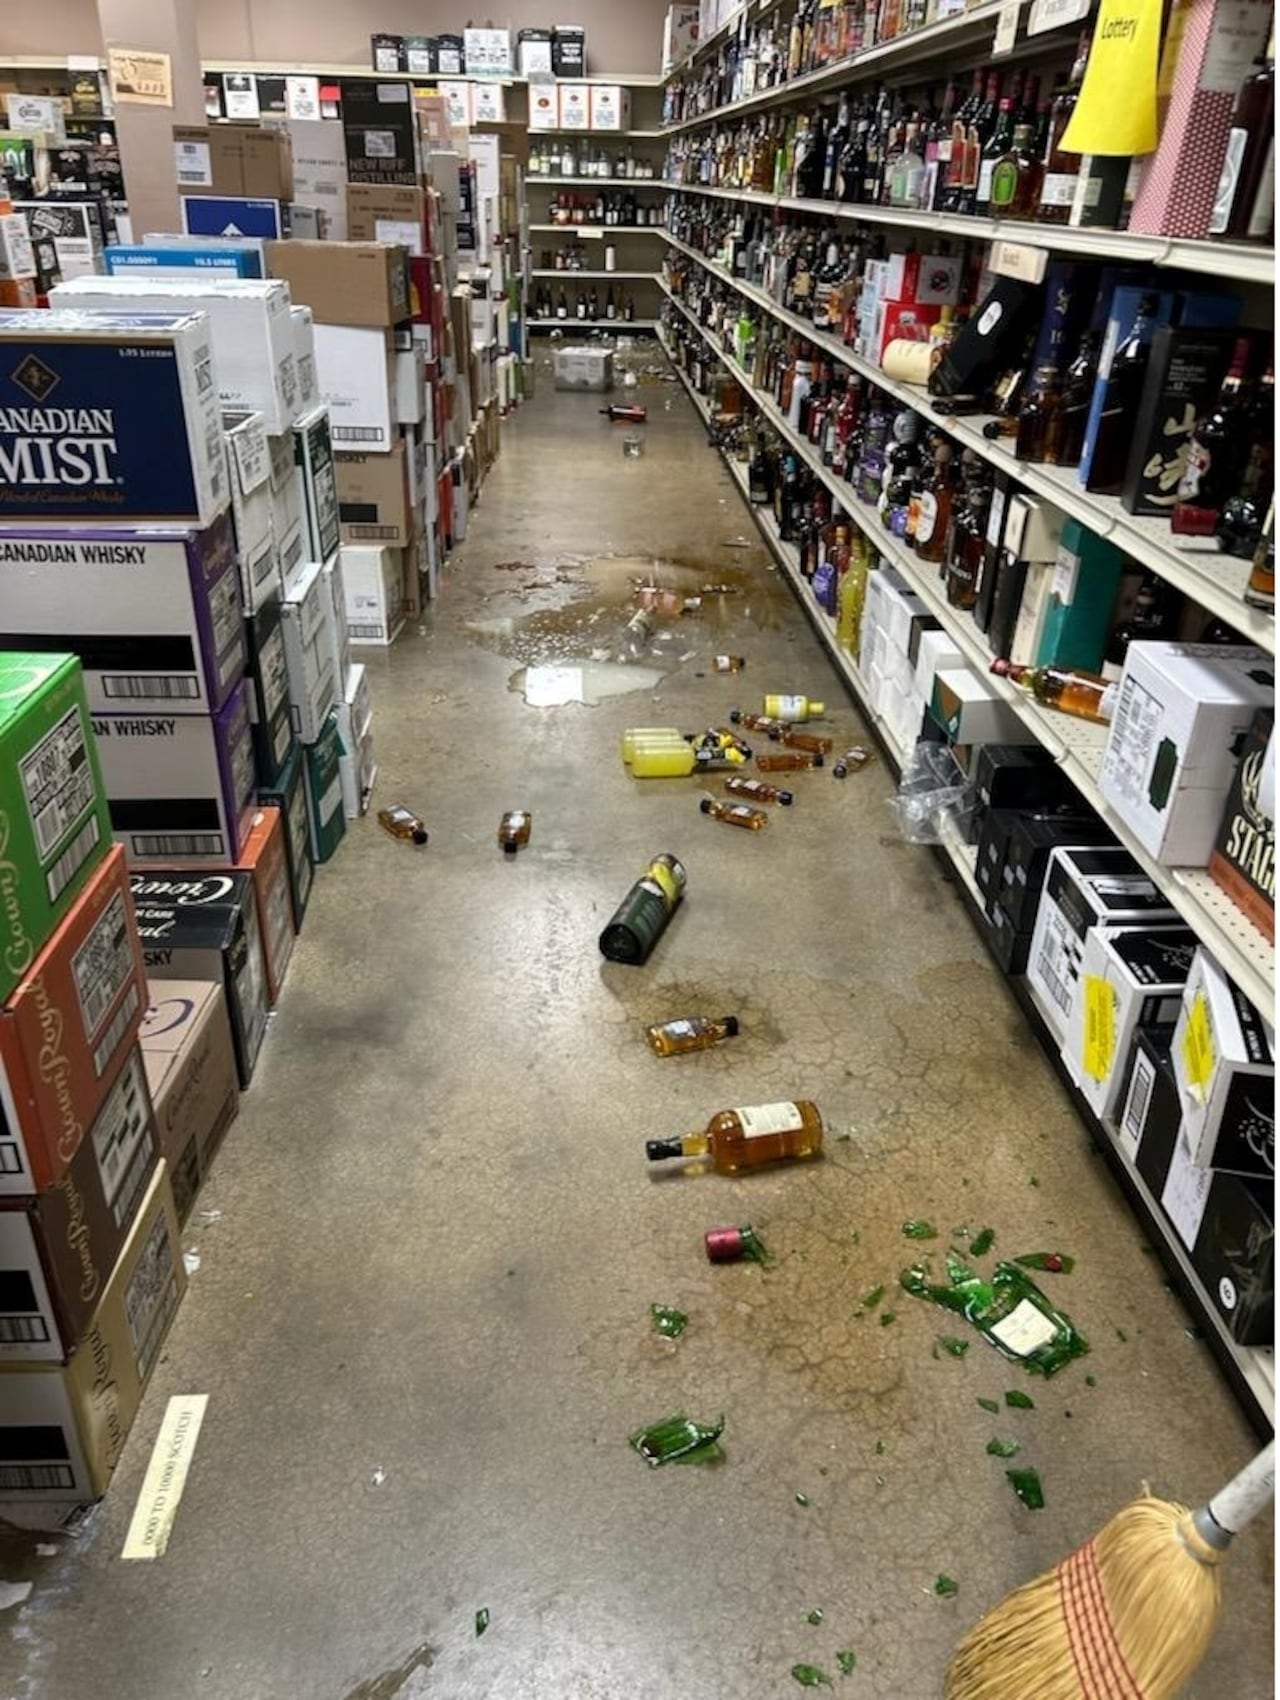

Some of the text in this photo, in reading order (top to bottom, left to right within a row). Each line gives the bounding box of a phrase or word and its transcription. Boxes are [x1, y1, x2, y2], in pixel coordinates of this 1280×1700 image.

[0, 406, 114, 434] ANADIAN
[0, 436, 118, 485] MIST
[79, 544, 146, 564] WHISKY
[113, 719, 176, 737] WHISKY
[1226, 814, 1275, 899] STAG
[143, 950, 172, 967] SKY
[168, 1410, 193, 1459] SCOTCH
